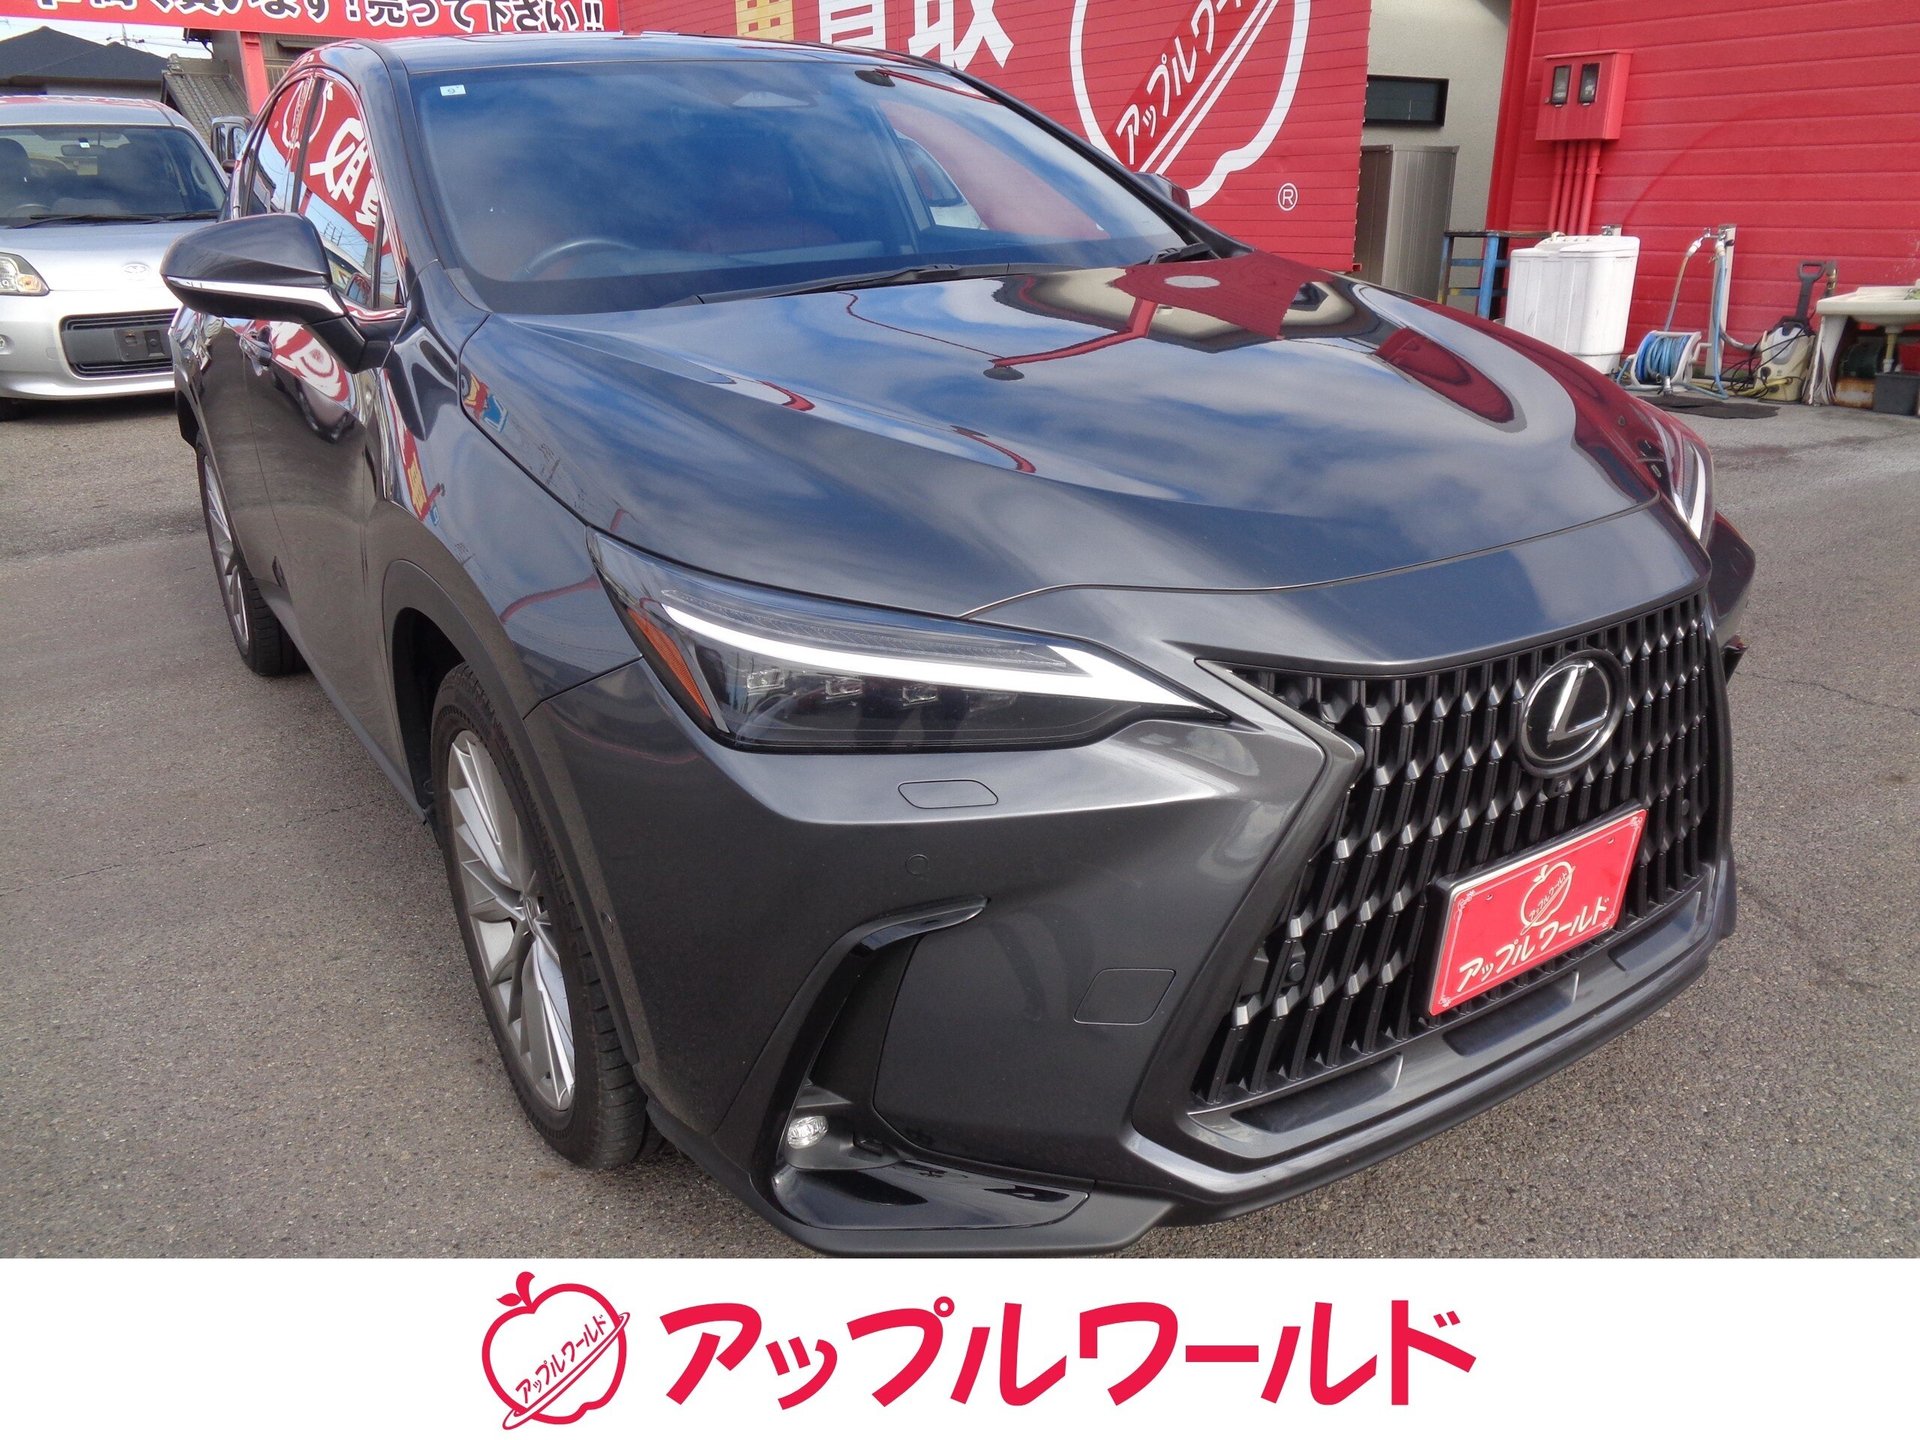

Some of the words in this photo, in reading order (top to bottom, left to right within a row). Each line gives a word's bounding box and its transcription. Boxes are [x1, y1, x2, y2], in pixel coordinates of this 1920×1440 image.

[1458, 896, 1609, 992] アップルワールド
